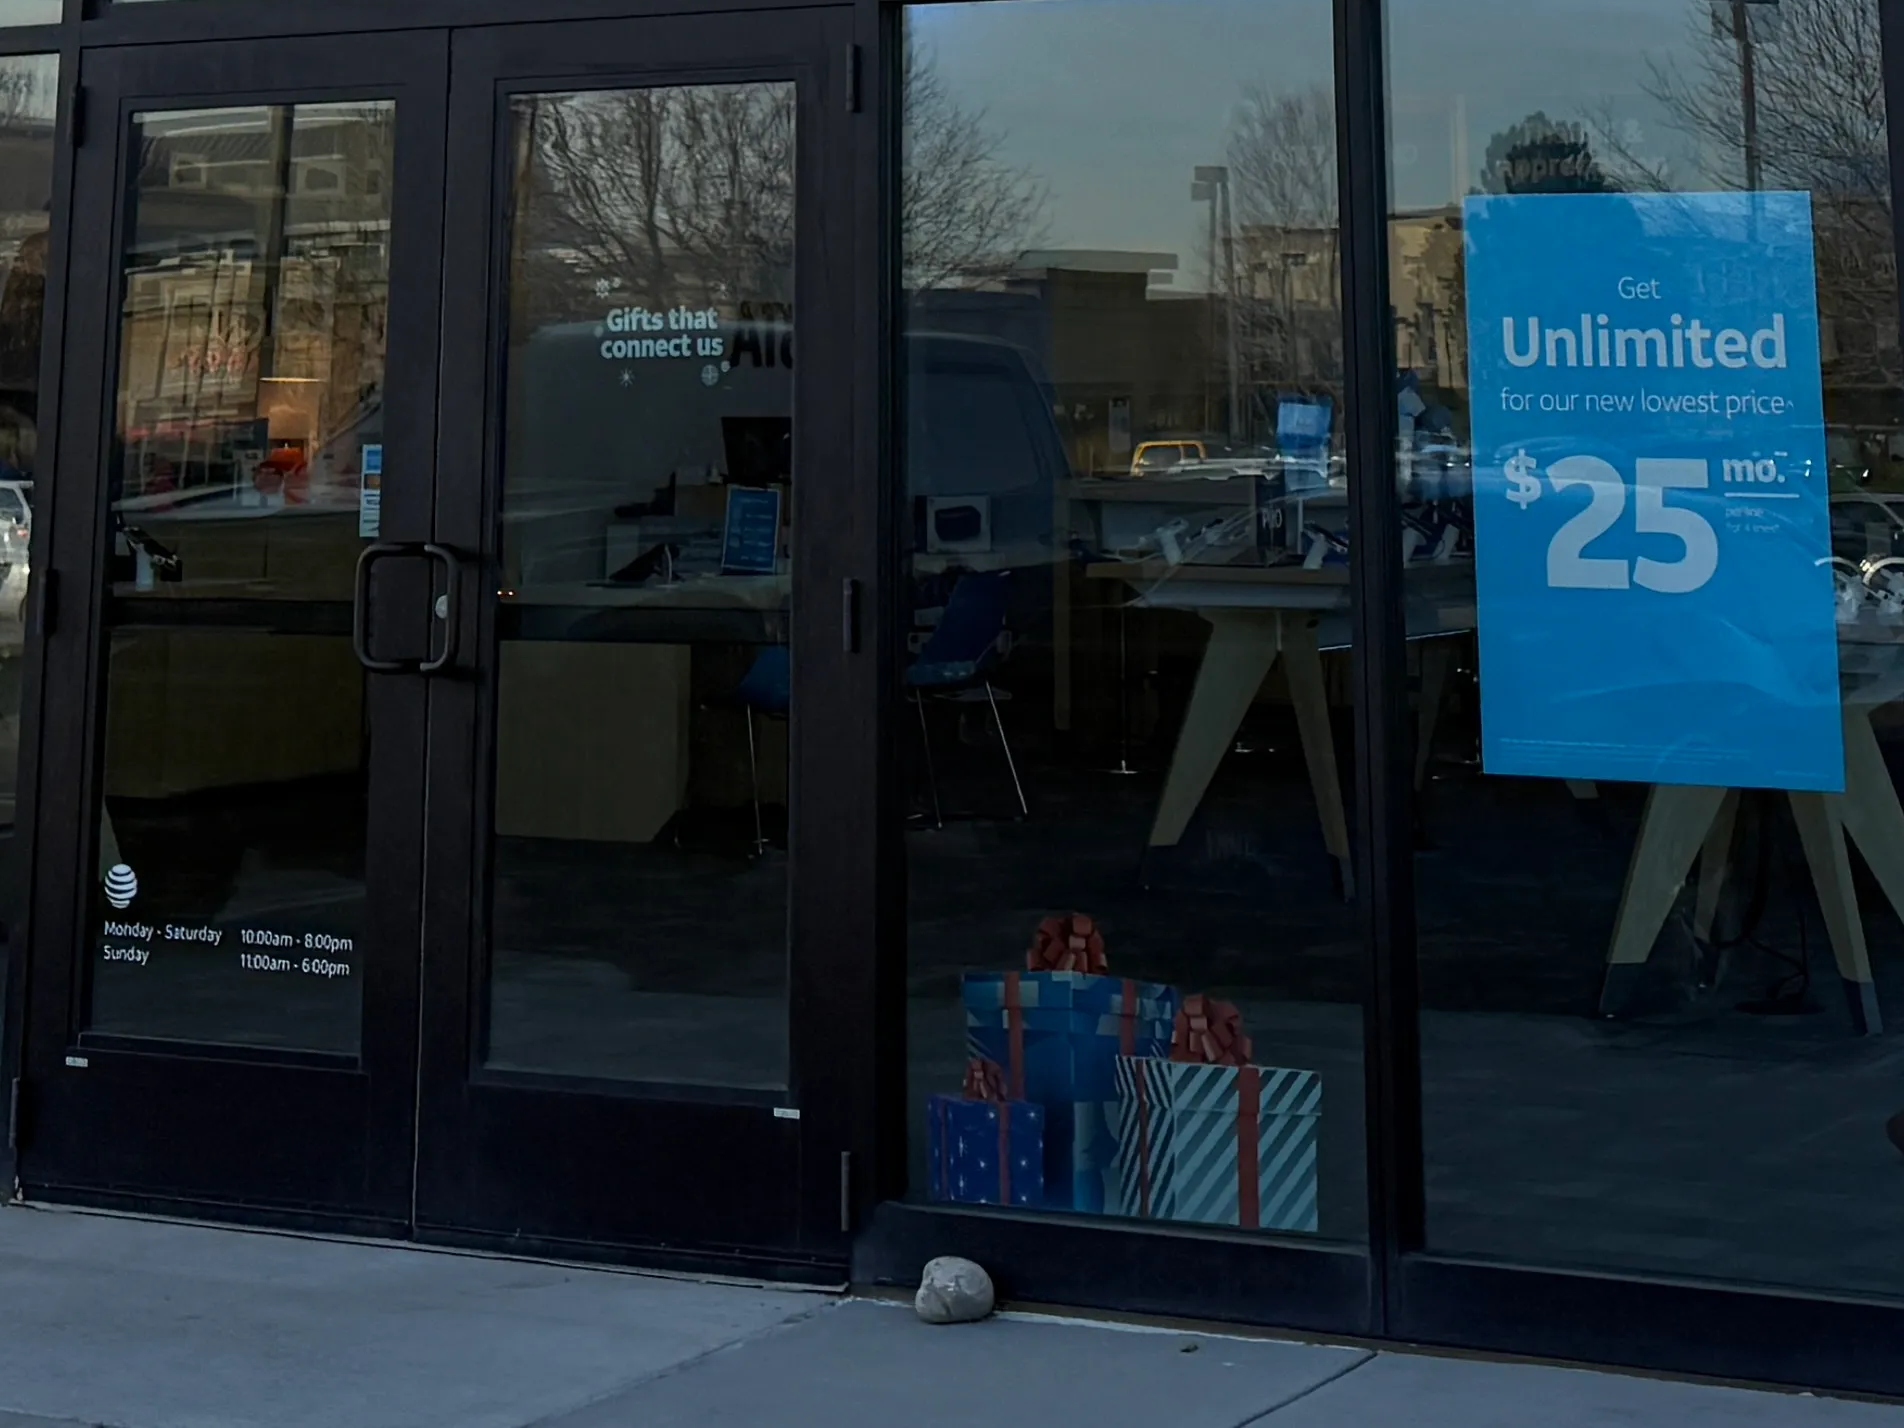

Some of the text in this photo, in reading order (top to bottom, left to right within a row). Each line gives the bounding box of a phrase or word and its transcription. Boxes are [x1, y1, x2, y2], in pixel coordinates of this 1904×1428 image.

[1617, 276, 1662, 300] Get
[606, 304, 719, 332] Gifts that
[600, 333, 725, 360] connect us
[1502, 312, 1788, 369] Unlimited
[1500, 386, 1534, 412] for
[1539, 393, 1580, 412] our
[1585, 393, 1634, 412] new
[1640, 388, 1720, 414] lowest
[1503, 448, 1719, 594] $25
[104, 920, 154, 942] Monday
[164, 924, 223, 946] Saturday
[103, 945, 150, 966] Sunday
